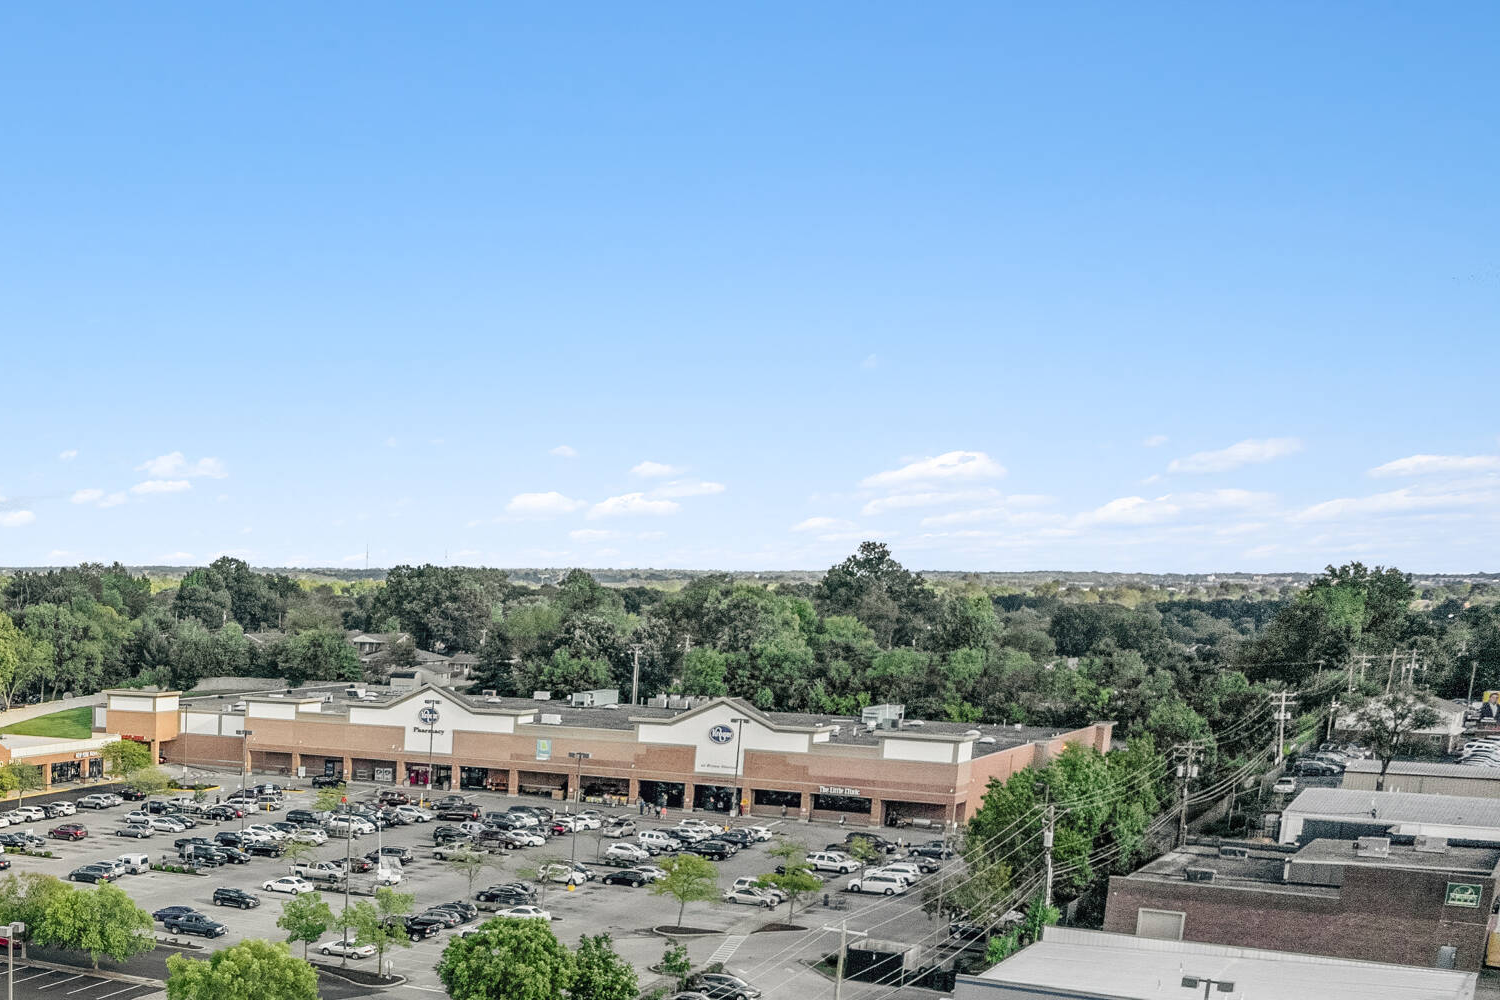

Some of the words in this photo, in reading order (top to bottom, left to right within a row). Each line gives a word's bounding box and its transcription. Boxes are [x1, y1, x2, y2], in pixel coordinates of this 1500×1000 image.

[413, 727, 444, 735] Pharmacy
[711, 726, 733, 742] Kroger
[819, 785, 830, 793] The
[829, 786, 845, 795] Little
[844, 787, 861, 796] Clinic
